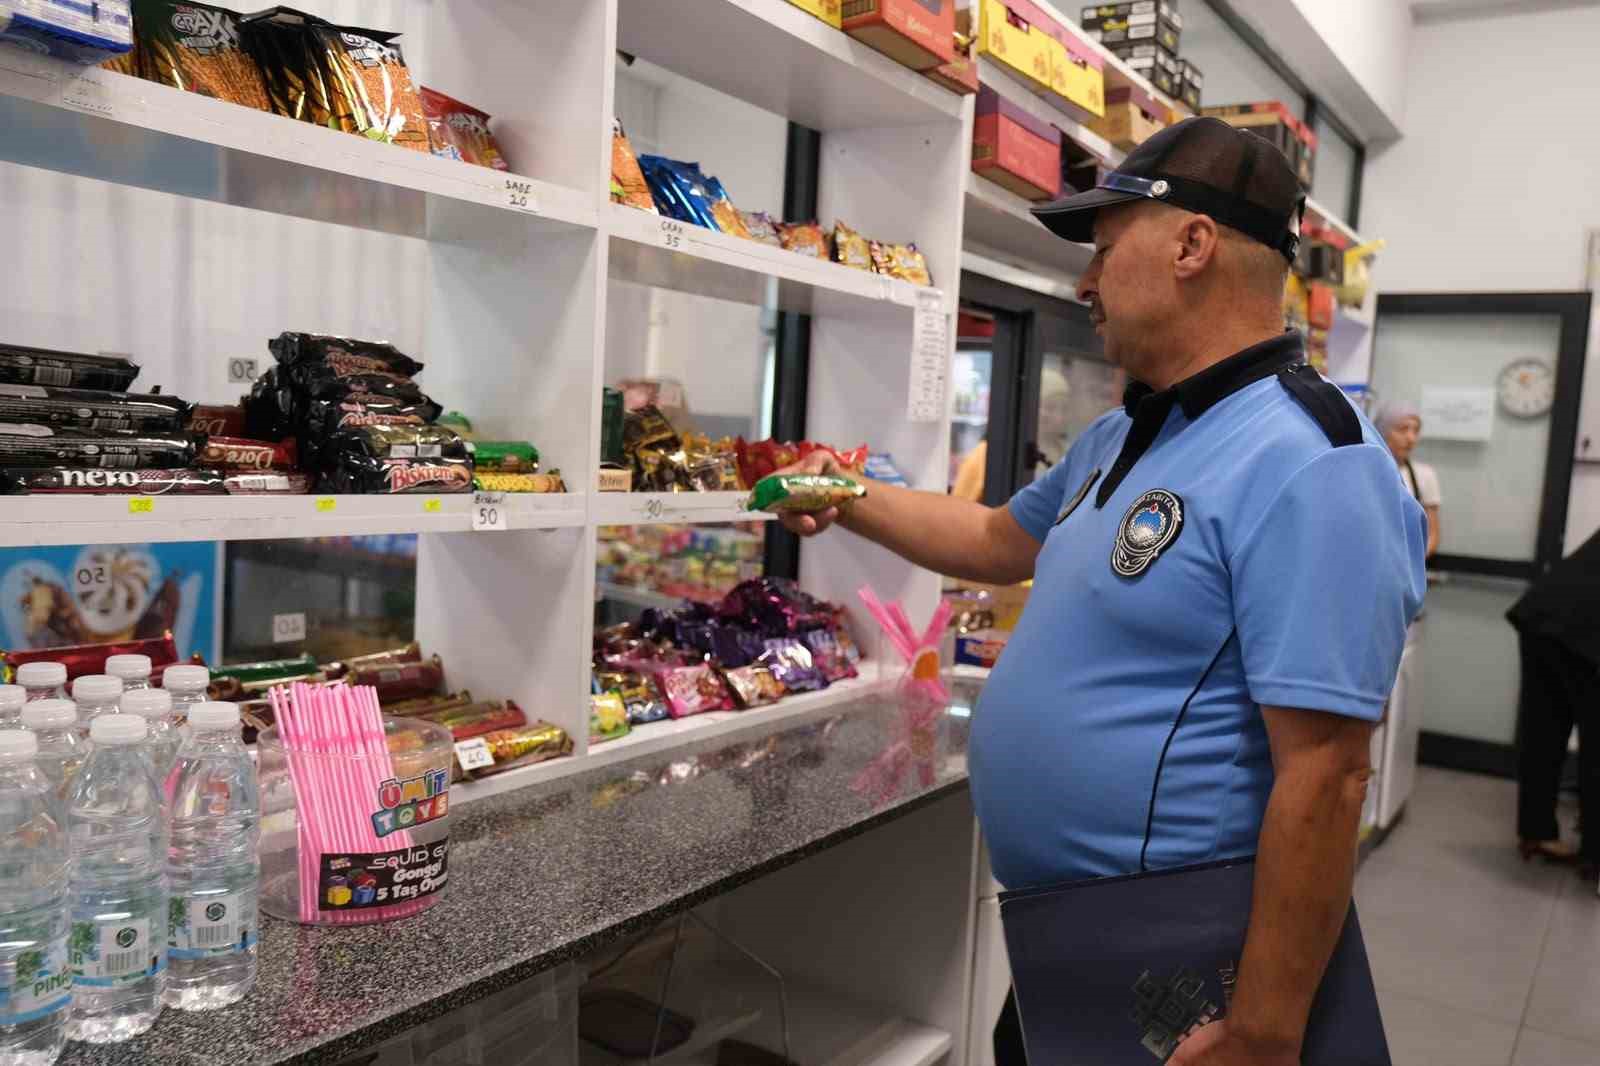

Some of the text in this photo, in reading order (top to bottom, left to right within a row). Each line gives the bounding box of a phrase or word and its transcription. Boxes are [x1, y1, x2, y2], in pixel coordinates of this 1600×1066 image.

[665, 233, 681, 248] 35
[224, 447, 275, 469] Dore
[61, 468, 140, 488] nero
[391, 464, 455, 491] Biskrem
[479, 507, 498, 525] 50
[377, 797, 448, 832] TOYS
[366, 847, 430, 870] SQUID
[392, 860, 443, 884] Gonggi
[376, 886, 389, 901] 5
[391, 882, 419, 899] Taş
